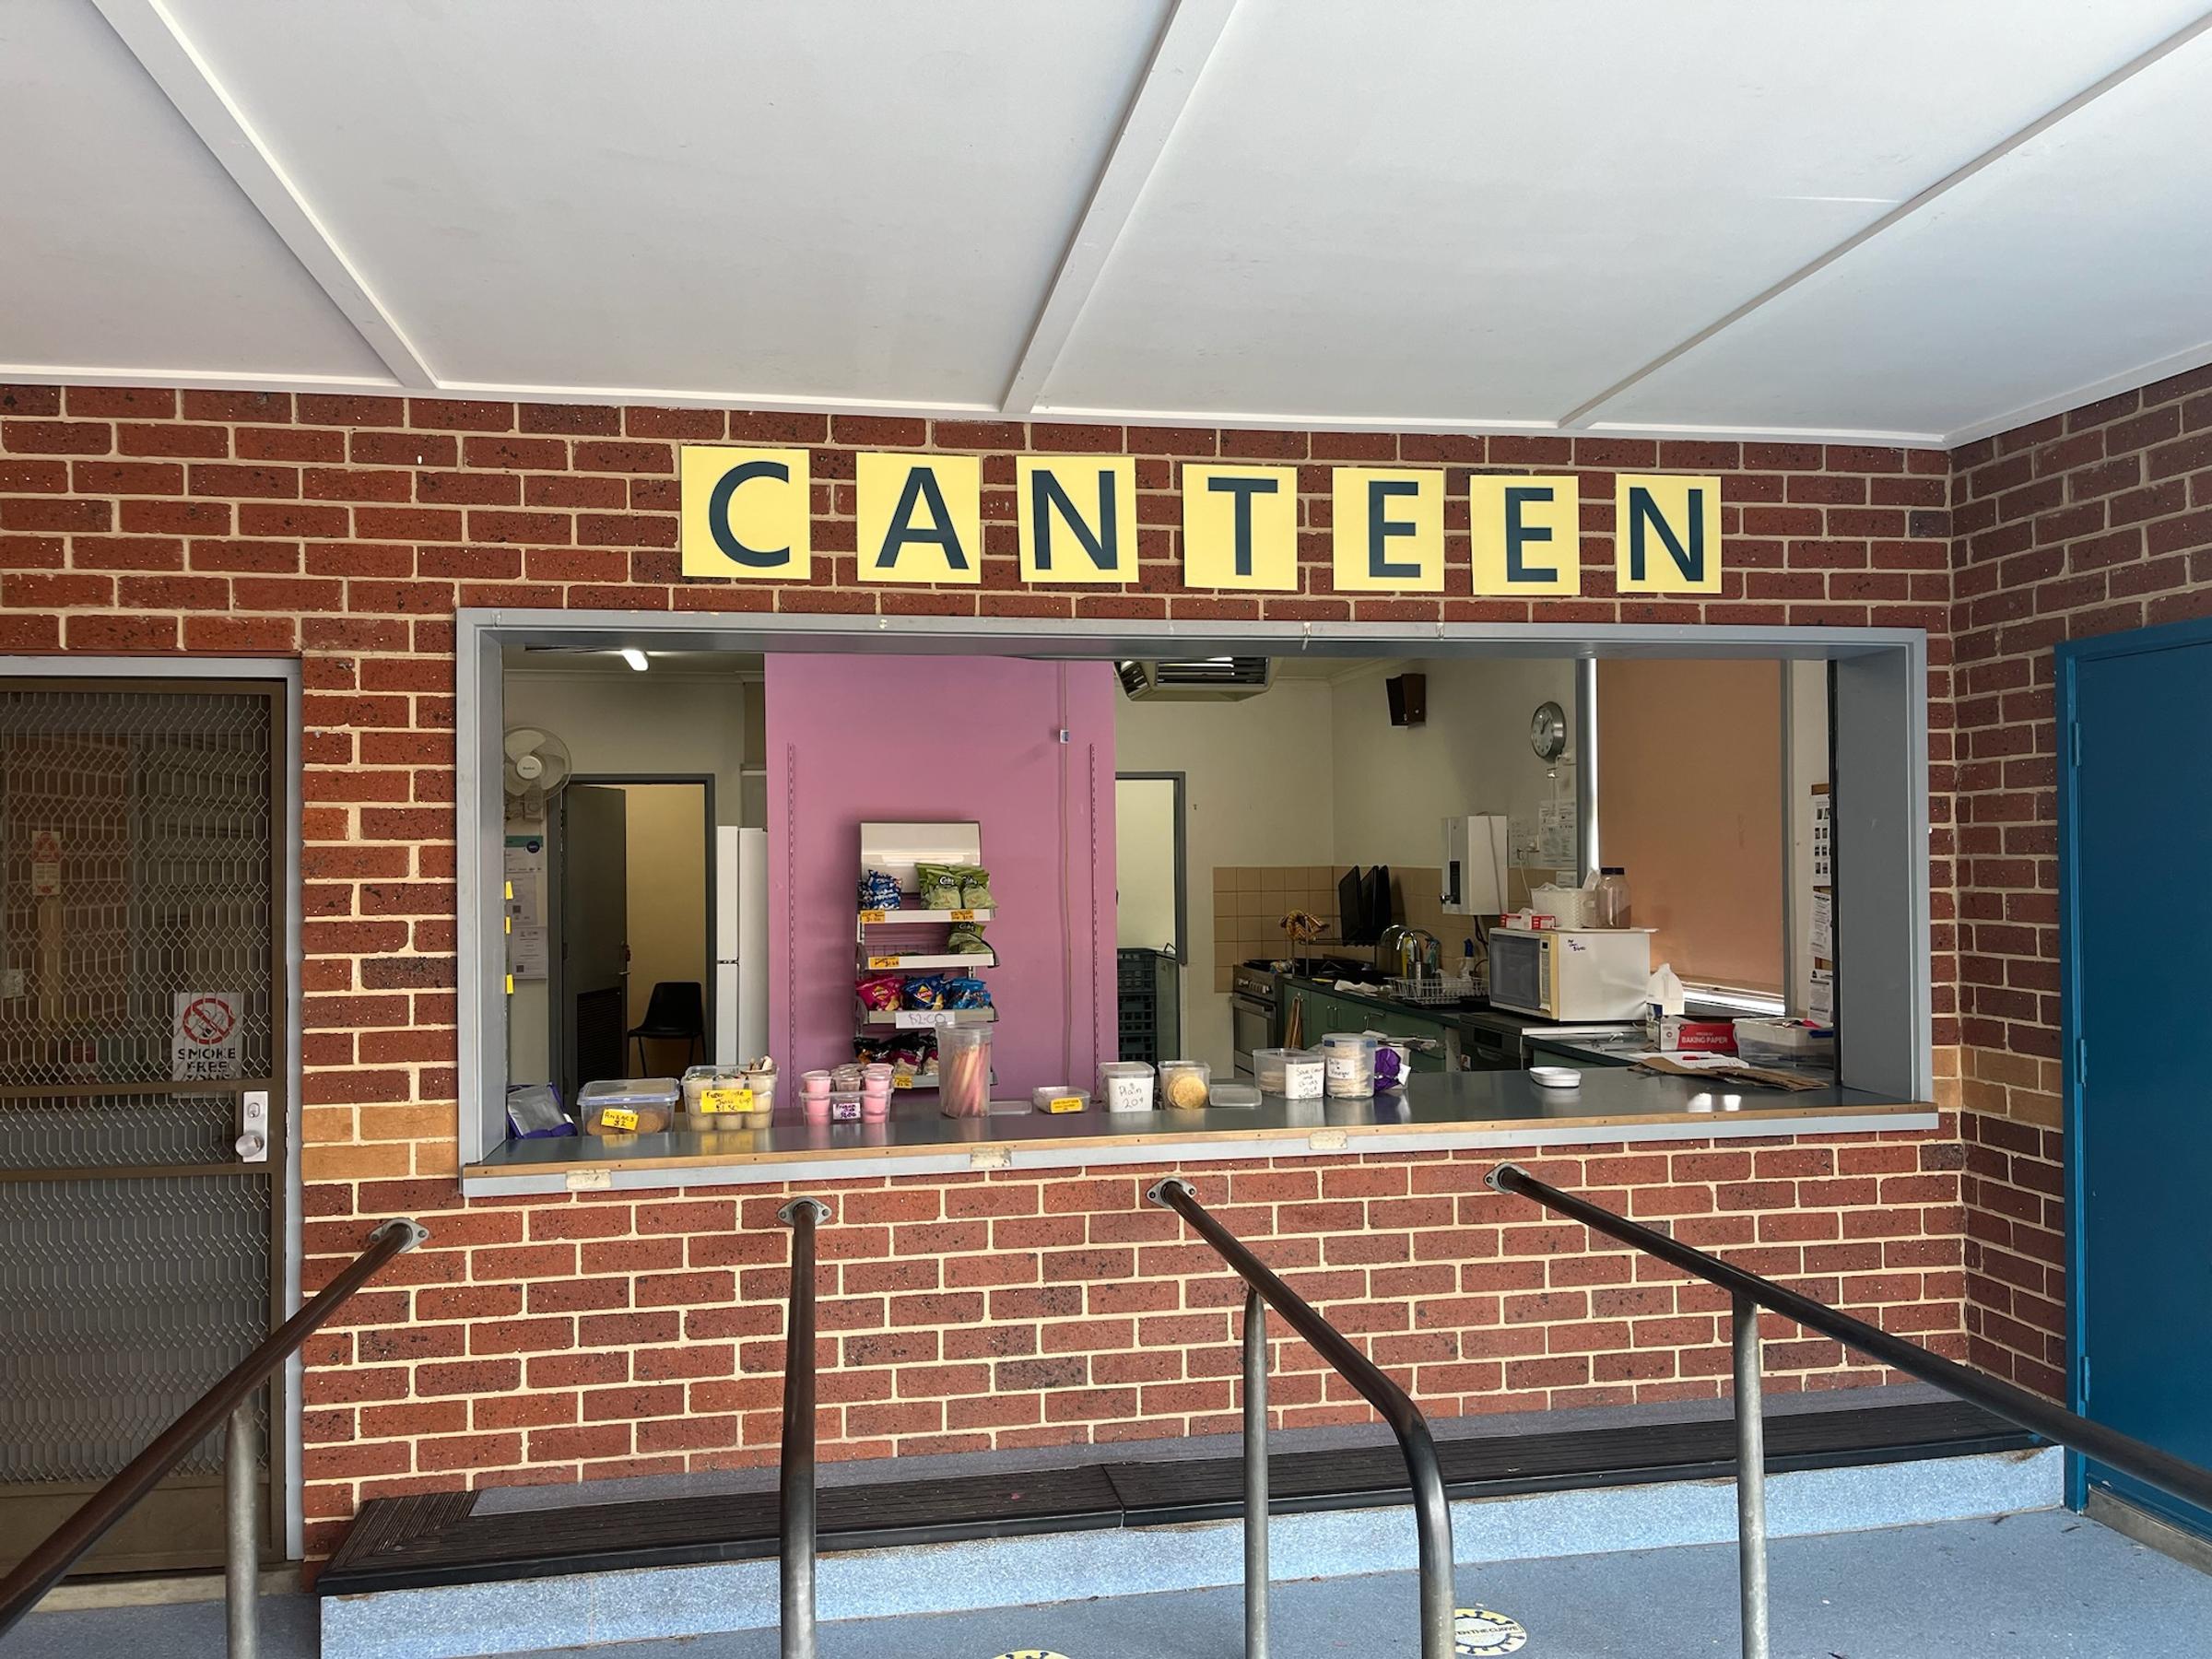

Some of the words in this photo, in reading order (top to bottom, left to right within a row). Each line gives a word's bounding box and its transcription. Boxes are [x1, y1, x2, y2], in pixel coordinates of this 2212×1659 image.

[709, 460, 1704, 582] CANTEEN
[1681, 1036, 1705, 1044] BAKING
[1707, 1036, 1728, 1044] PAPER
[178, 1048, 236, 1059] SMOKE
